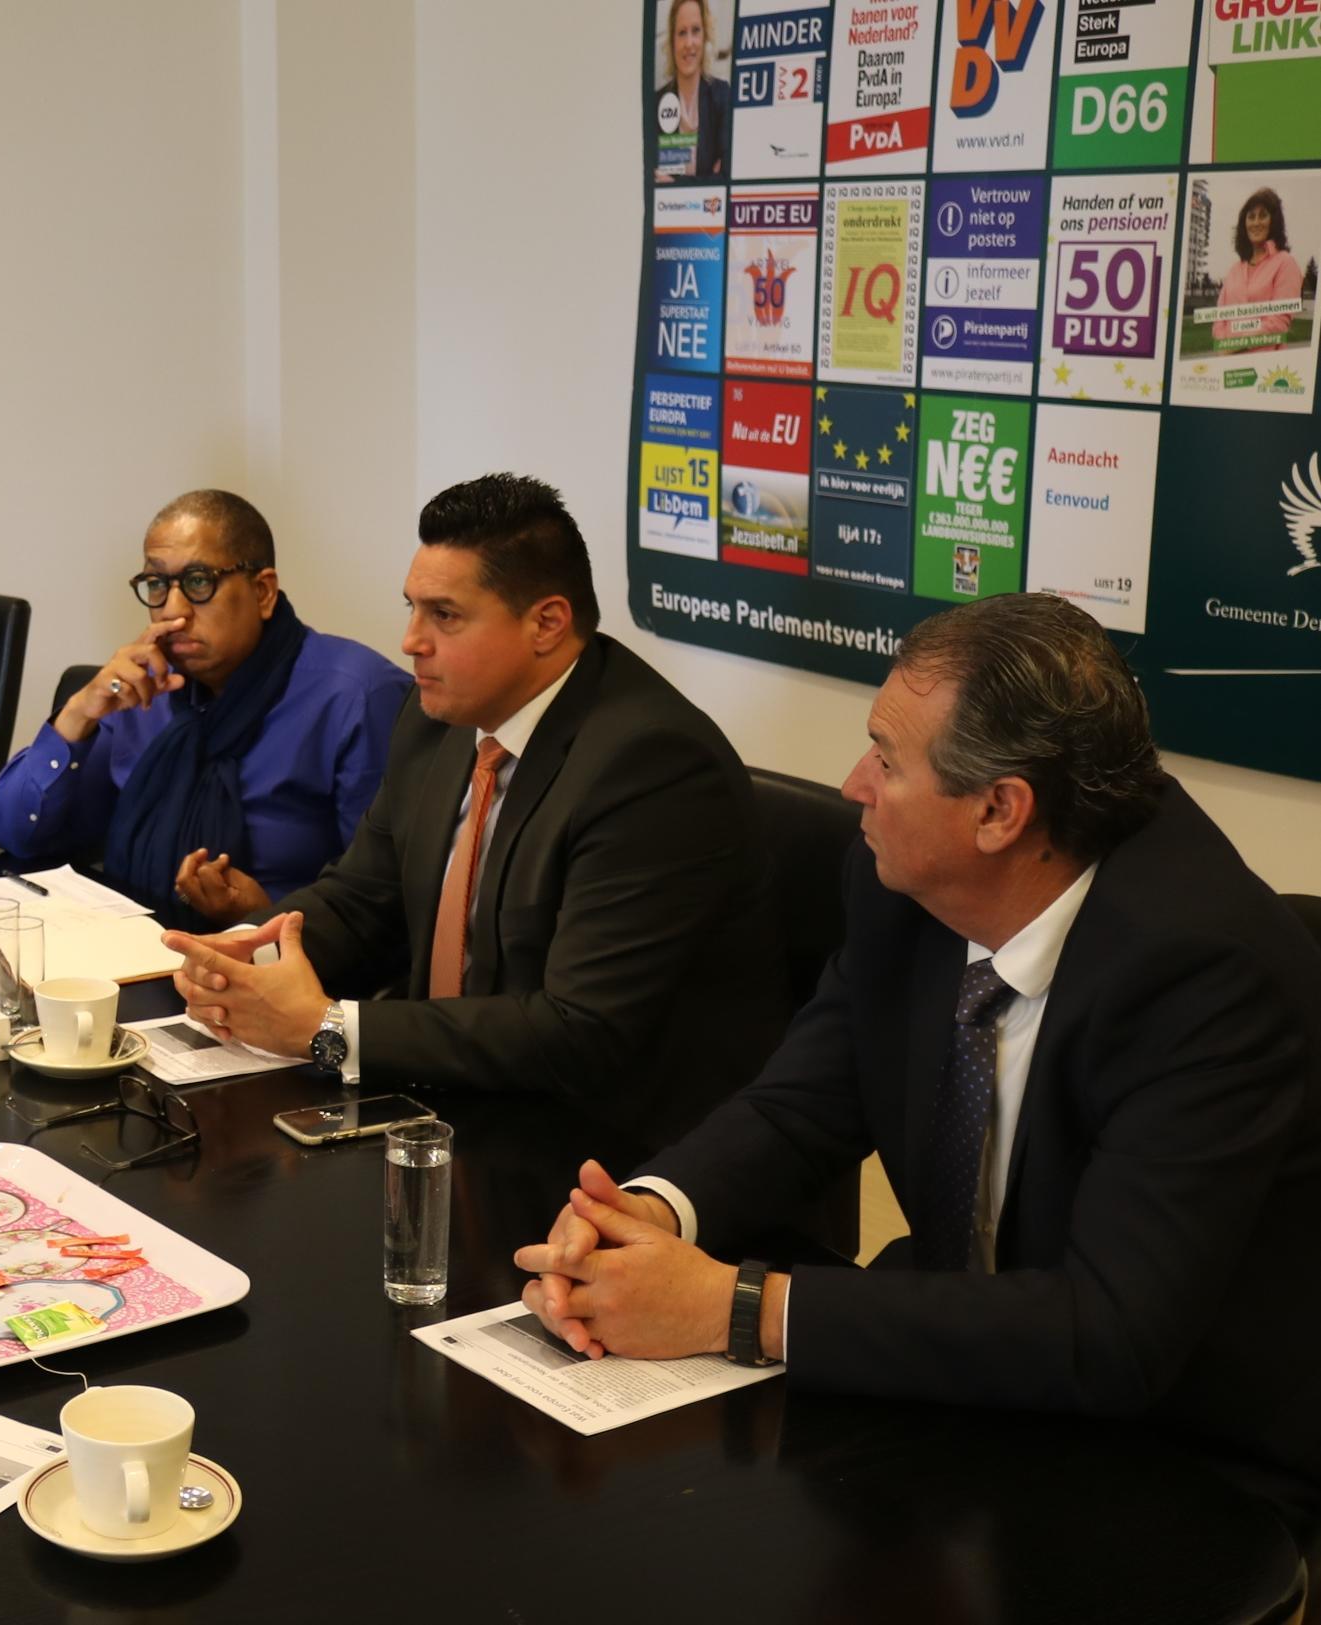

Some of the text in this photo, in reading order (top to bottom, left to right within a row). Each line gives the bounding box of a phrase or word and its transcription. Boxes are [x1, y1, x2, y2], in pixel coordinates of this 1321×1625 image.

[852, 6, 918, 25] banen voor
[1079, 13, 1116, 31] Sterk
[741, 17, 822, 50] MINDER
[848, 21, 918, 46] Nederland?
[1232, 16, 1321, 54] LINK
[858, 50, 904, 67] Daarom
[1077, 40, 1127, 58] Europa
[738, 70, 768, 102] EU
[791, 68, 808, 99] 2
[858, 68, 902, 87] PvdA in
[856, 88, 901, 109] Europa!
[1072, 82, 1168, 136] D66
[956, 133, 1024, 149] www.vvd.nl
[970, 186, 1030, 203] Vertrouw
[1062, 193, 1163, 210] Handen af van
[735, 205, 759, 224] UIT
[764, 205, 784, 223] DE
[790, 204, 811, 223] EU
[843, 216, 901, 227] onderdrukt
[969, 210, 1014, 229] niet op
[1060, 213, 1168, 234] ons pensioen!
[968, 233, 1016, 251] posters
[656, 247, 720, 261] SAMENWERKING
[670, 264, 699, 299] JA
[967, 264, 1030, 280] informeer
[1065, 248, 1146, 312] 50
[754, 277, 785, 308] 50
[838, 263, 901, 325] IQ
[966, 285, 1001, 302] jezelf
[660, 305, 710, 319] SUPERSTAAT
[657, 321, 708, 359] NEE
[964, 320, 1028, 339] Piratenpartij
[1064, 318, 1138, 348] PLUS
[931, 368, 1023, 384] www.piratenpartij.nl
[650, 391, 712, 410] PERSPECTIEF
[649, 408, 687, 425] EUROPA
[951, 409, 995, 443] ZEG
[732, 414, 800, 446] Nu uit de EU
[1047, 447, 1119, 469] Aandacht
[655, 459, 709, 487] LIJST 15
[926, 439, 1018, 505] N€€
[851, 481, 871, 492] voor
[872, 483, 904, 499] eerlijk
[1045, 488, 1109, 511] Eenvoud
[653, 493, 702, 517] LibDem
[955, 501, 983, 517] TEGEN
[731, 527, 798, 553] Jezusleeft.nl
[1117, 577, 1132, 592] 19
[651, 583, 730, 622] Europese
[1206, 598, 1321, 632] Gemeente De
